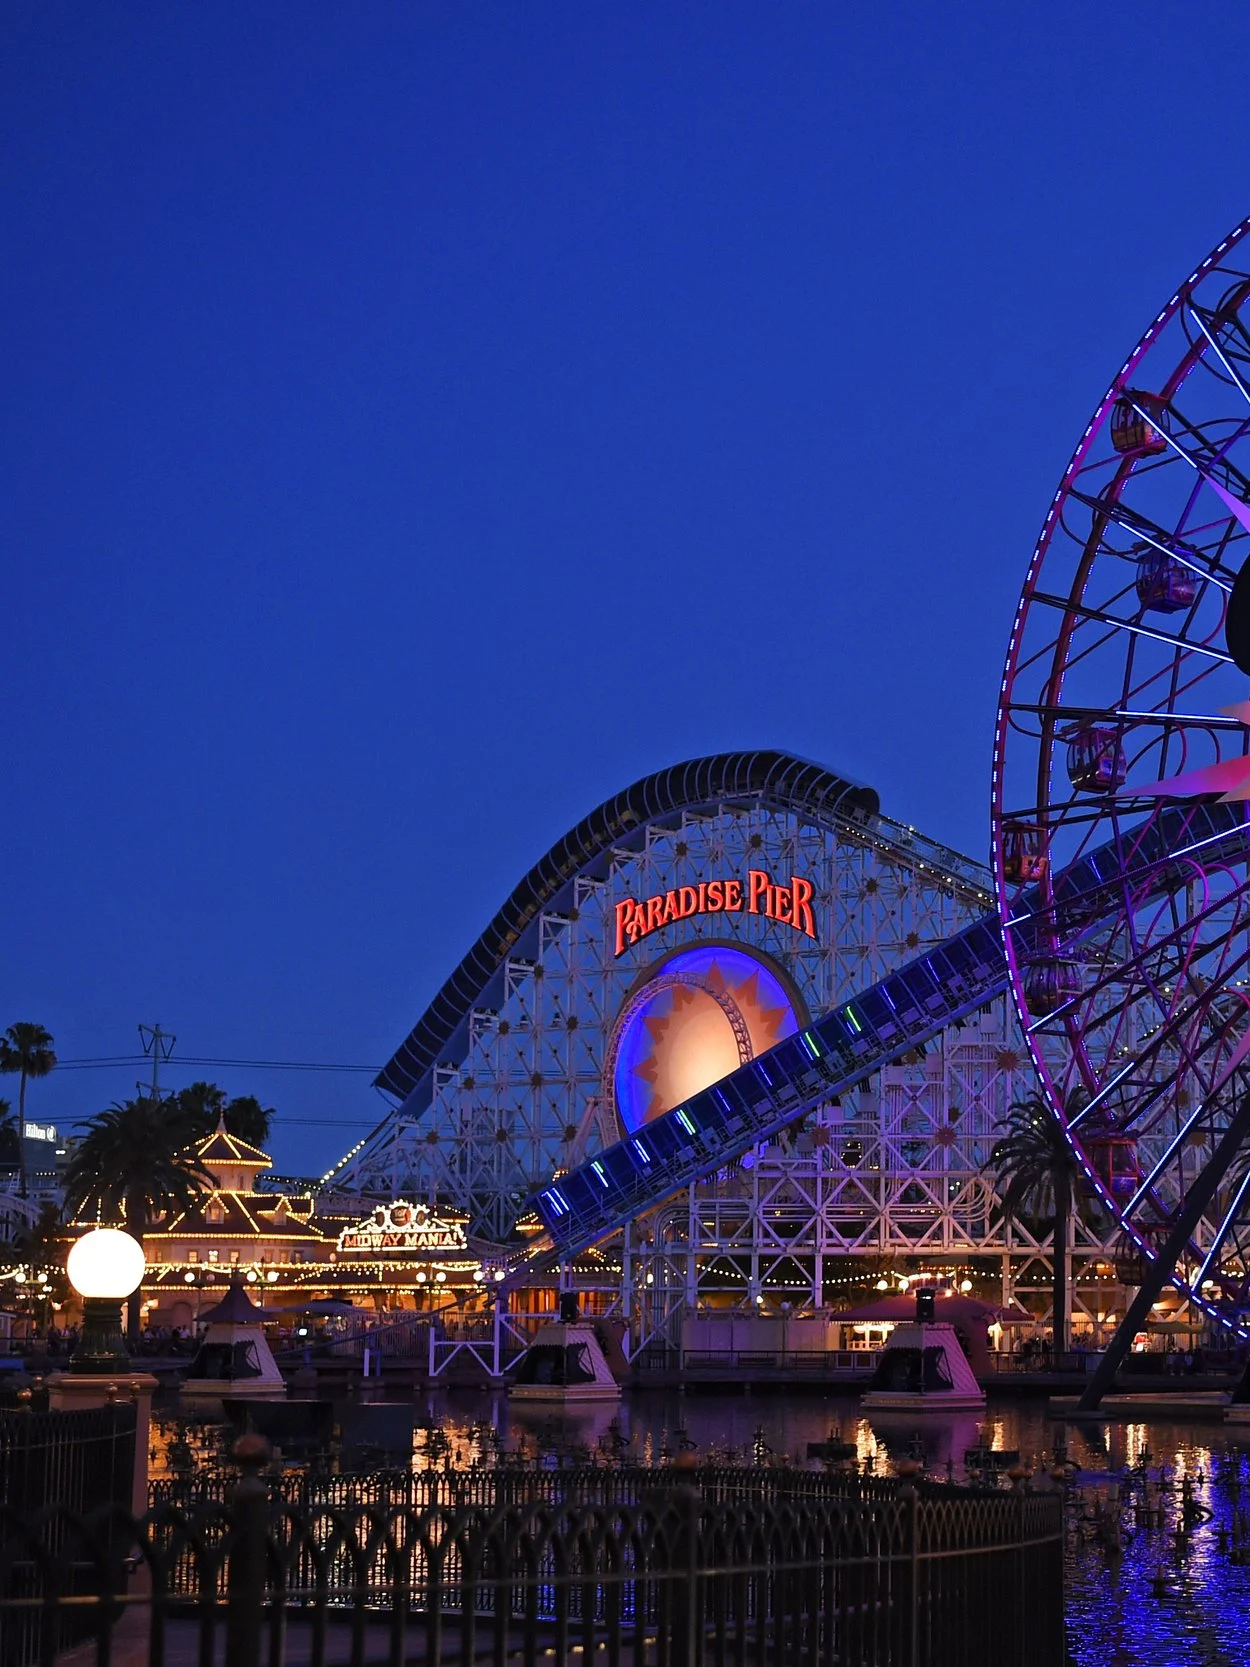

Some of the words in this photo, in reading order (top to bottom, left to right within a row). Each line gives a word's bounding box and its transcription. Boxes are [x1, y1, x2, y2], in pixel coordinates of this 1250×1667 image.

[614, 880, 742, 956] PARADISE
[748, 870, 816, 939] PIER
[344, 1233, 402, 1247] MIDWAY
[404, 1232, 458, 1247] MANIA!
